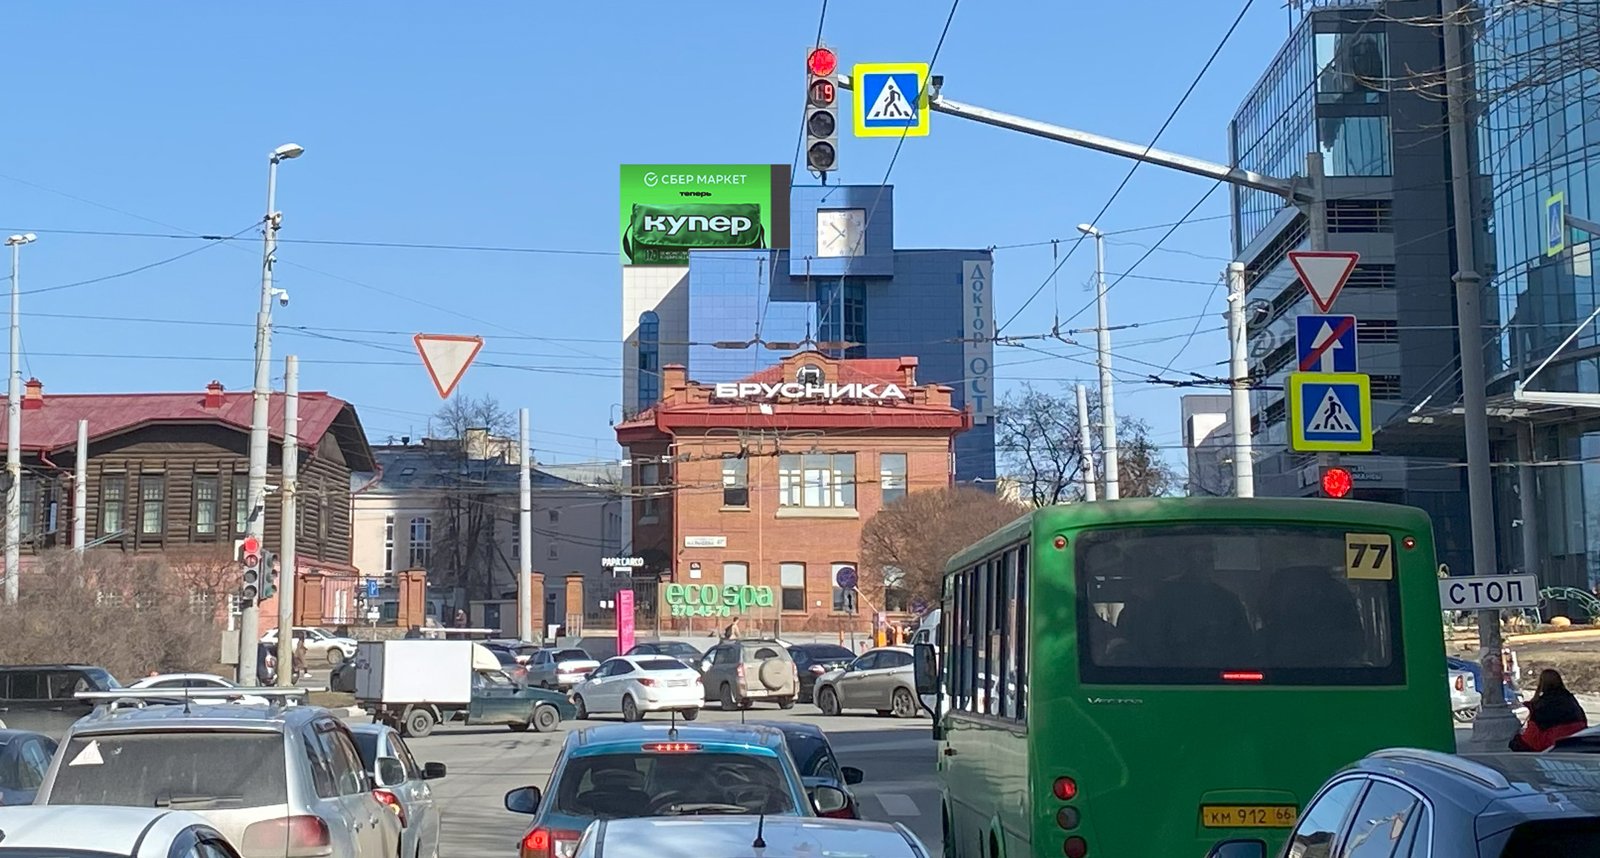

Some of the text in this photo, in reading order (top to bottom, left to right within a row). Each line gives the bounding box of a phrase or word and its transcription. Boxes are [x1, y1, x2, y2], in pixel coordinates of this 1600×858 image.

[661, 174, 747, 185] СБЕР МАРКЕТ
[644, 216, 752, 236] купер
[970, 263, 985, 348] ДОКТОР
[714, 382, 906, 398] БРУСНИКА
[969, 357, 988, 413] ОСТ
[1349, 543, 1388, 569] 77
[666, 583, 774, 614] eco spa
[1449, 580, 1523, 605] СТОП
[1238, 808, 1266, 824] 912
[1276, 808, 1291, 819] 66
